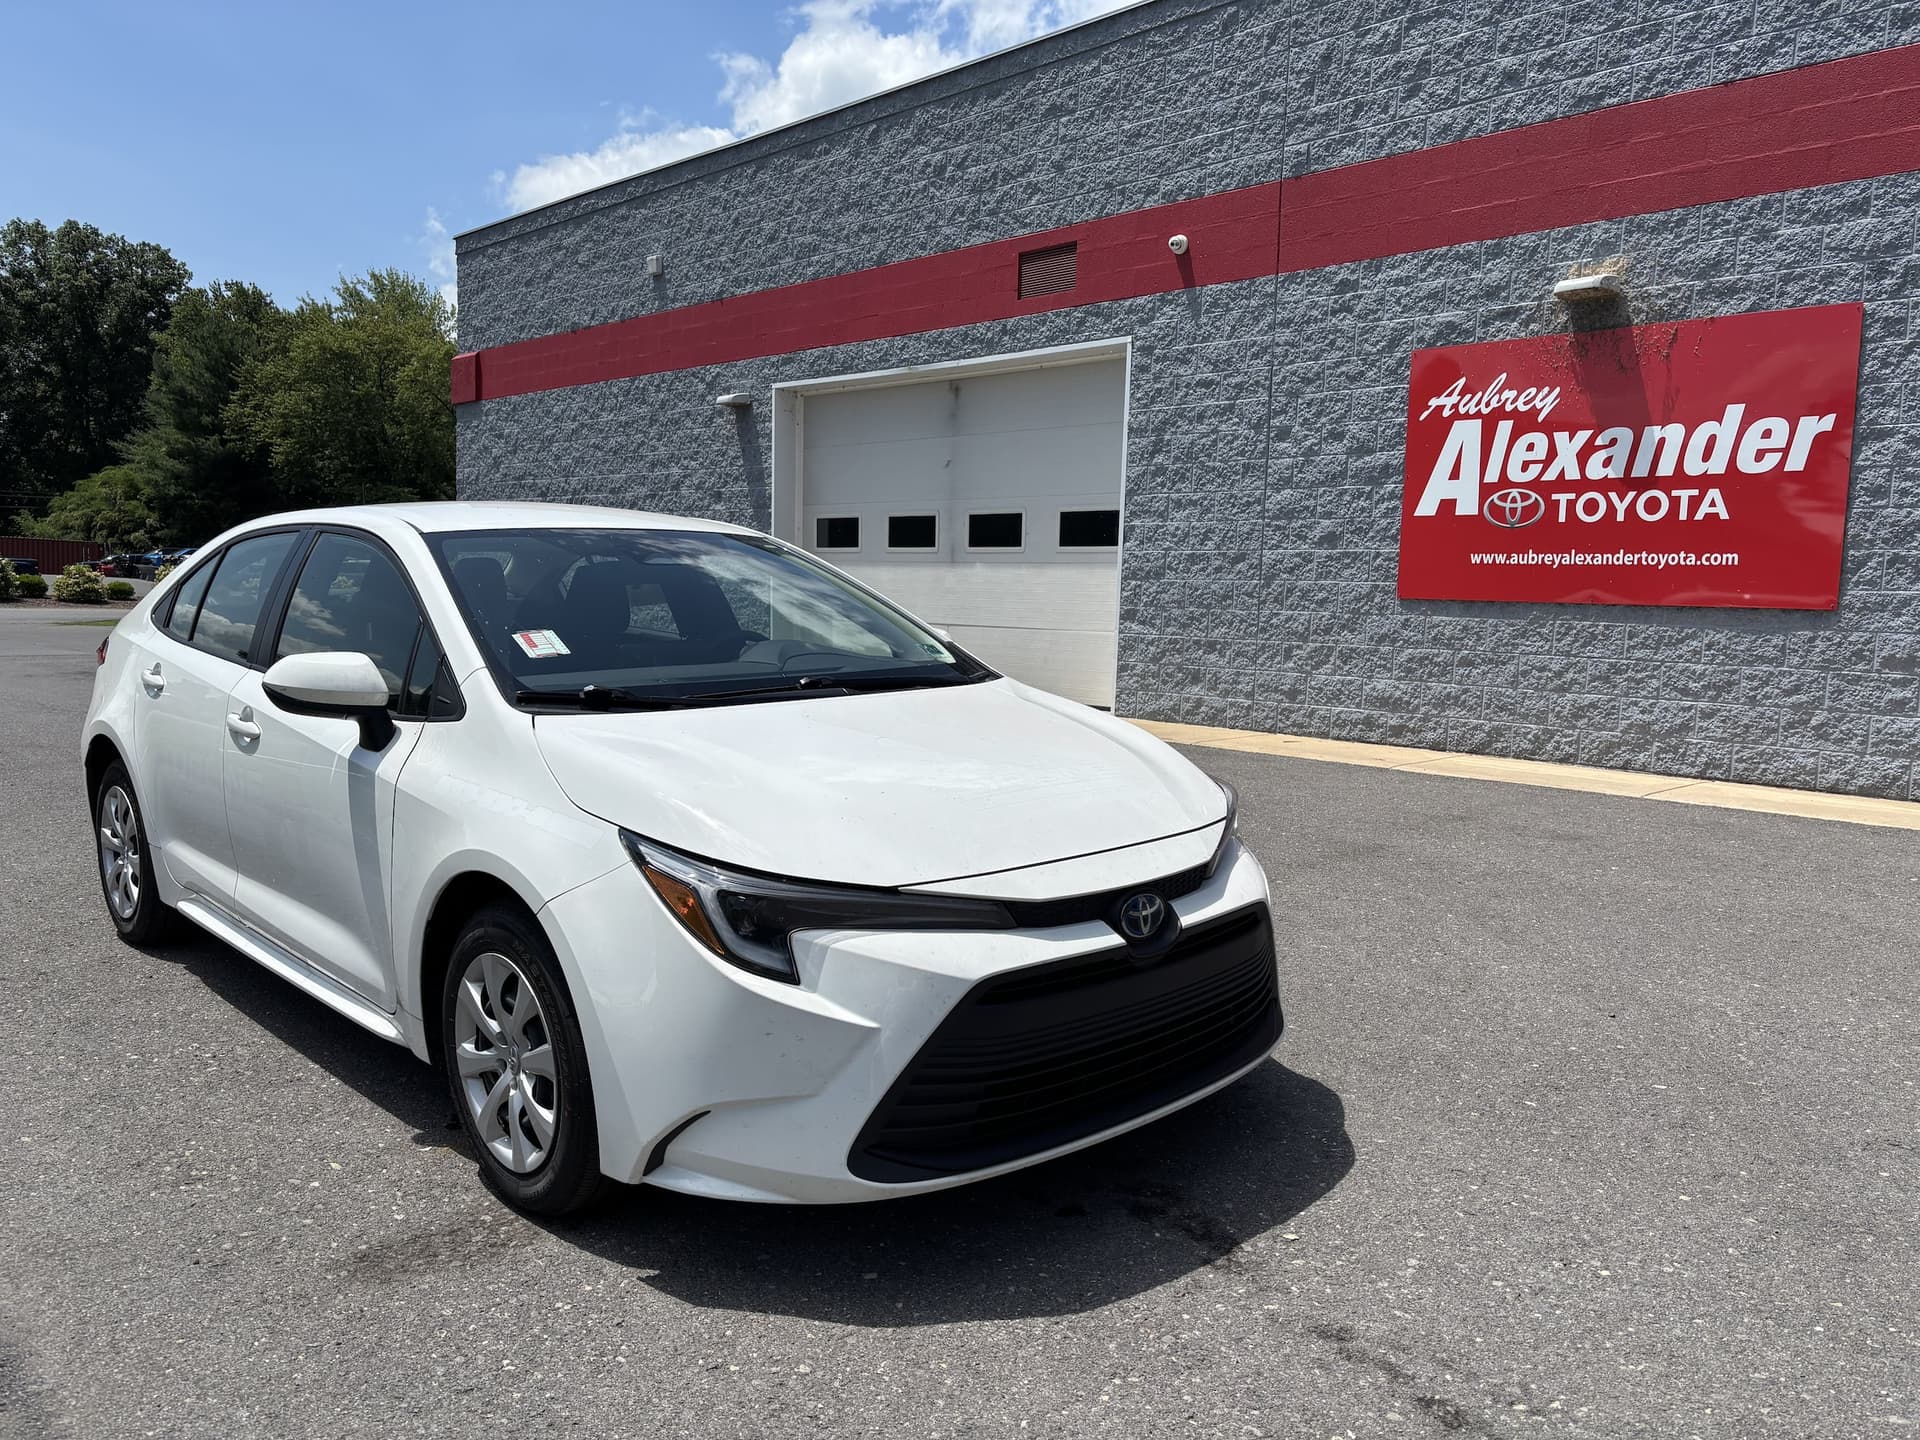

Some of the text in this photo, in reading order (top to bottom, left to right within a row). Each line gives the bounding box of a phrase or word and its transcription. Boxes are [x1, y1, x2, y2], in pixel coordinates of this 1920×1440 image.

[1419, 372, 1561, 423] Aubrey
[1413, 402, 1837, 517] Alexander
[1552, 489, 1730, 523] TOYOTA
[1470, 549, 1739, 570] www.aubreyalexandertoyota.com
